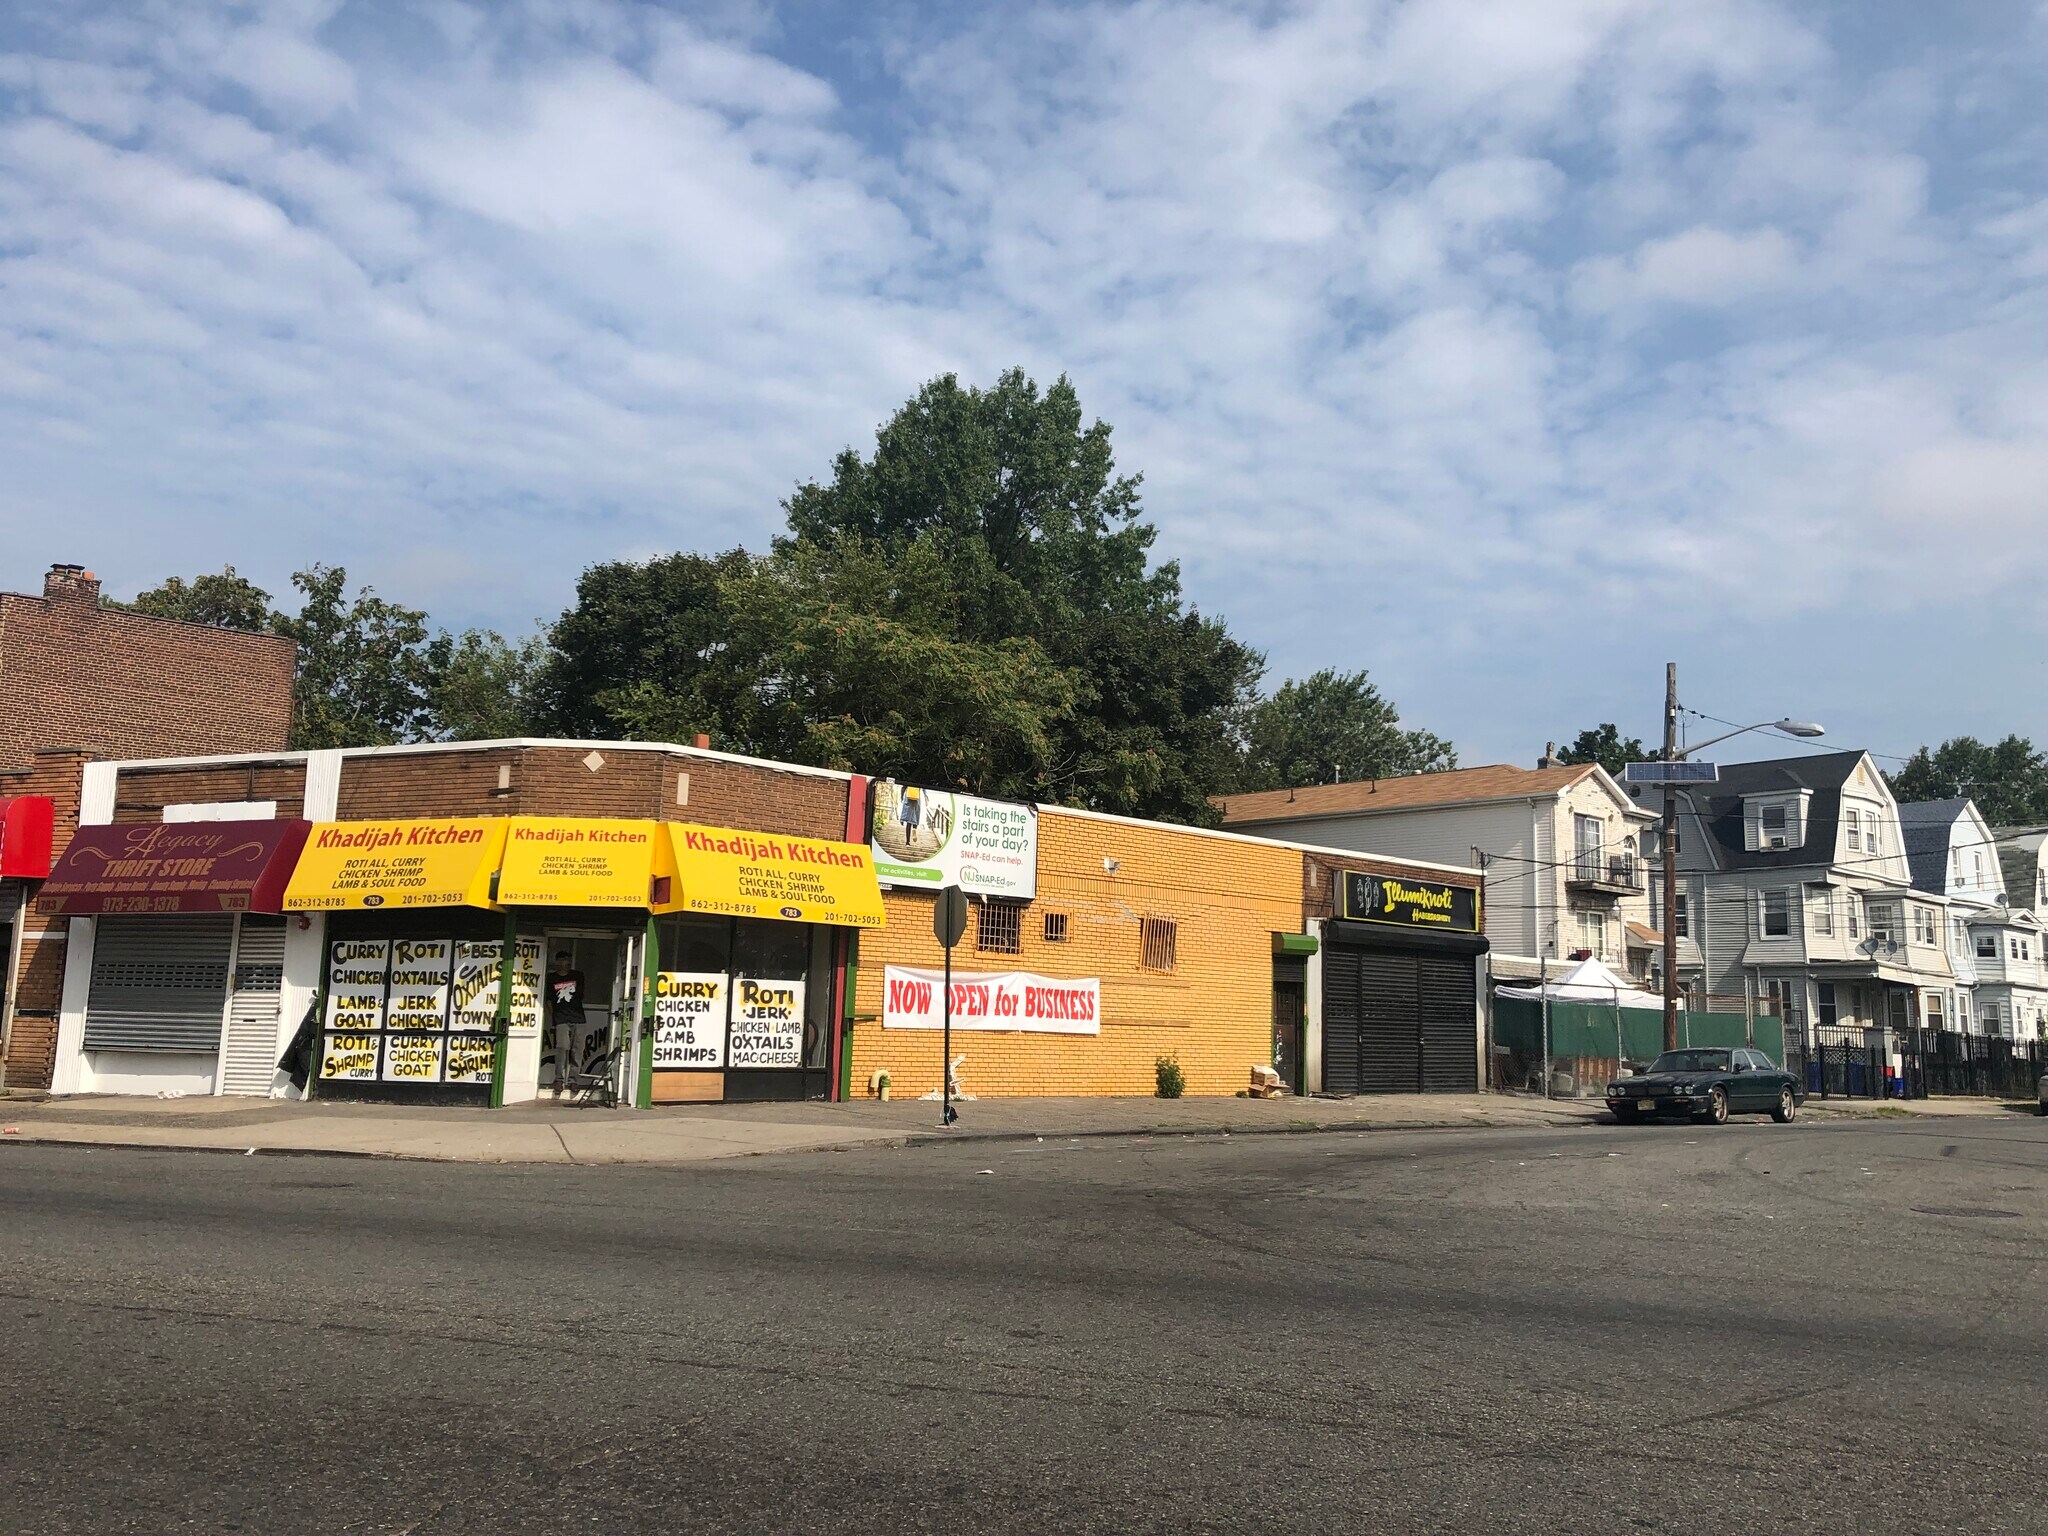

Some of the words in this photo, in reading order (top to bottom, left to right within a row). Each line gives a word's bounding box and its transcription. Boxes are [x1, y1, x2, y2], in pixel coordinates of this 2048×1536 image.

[963, 803, 971, 816] Is
[973, 805, 1007, 824] taking
[1010, 811, 1027, 824] the
[515, 828, 584, 844] Khadijah
[589, 830, 647, 843] Kitchen
[962, 818, 989, 833] stairs
[992, 825, 1000, 834] a
[1002, 825, 1025, 840] part
[124, 824, 227, 859] Legacy
[316, 827, 403, 852] Khadijah
[405, 825, 484, 846] Kitchen
[962, 833, 974, 845] of
[975, 837, 998, 850] your
[1001, 839, 1029, 854] day?
[685, 831, 784, 862] Khadijah
[787, 843, 865, 868] Kitchen
[345, 858, 368, 868] ROTI
[367, 858, 390, 869] ALL,
[391, 857, 426, 867] CURRY
[960, 850, 991, 862] SNAP-Ed
[992, 854, 1005, 863] can
[1006, 855, 1024, 867] help.
[102, 859, 161, 878] THRIFT
[158, 857, 216, 877] STORE
[338, 869, 380, 879] CHICKEN
[383, 867, 423, 878] SHRIMP
[739, 866, 764, 877] ROTI
[765, 869, 787, 881] ALL,
[788, 872, 820, 883] CURRY
[331, 879, 360, 889] LAMB
[360, 879, 369, 888] &
[369, 878, 396, 888] SOUL
[397, 877, 427, 887] FOOD
[739, 876, 783, 889] CHICKEN
[787, 882, 825, 894] SHRIMP
[228, 897, 246, 908] 783
[288, 898, 346, 907] 862-312-8785
[366, 896, 380, 905] 783
[402, 893, 463, 904] 201-702-5053
[504, 893, 558, 901] 862-312-8785
[589, 895, 642, 903] 201-702-5053
[738, 886, 769, 898] LAMB
[770, 890, 779, 899] &
[779, 891, 807, 902] SOUL
[808, 893, 836, 905] FOOD
[40, 899, 57, 911] 783
[102, 897, 180, 912] 973-230-1378
[691, 899, 757, 914] 862-312-8785
[784, 908, 798, 917] 783
[824, 912, 881, 925] 201-702-5053
[332, 942, 386, 965] CURRY
[395, 941, 446, 965] ROTI
[514, 943, 540, 959] ROTI
[332, 969, 386, 986] CHICKEN
[391, 970, 448, 986] OXTAILS
[511, 972, 540, 988] CURRY
[453, 960, 502, 1011] OXTAILS
[656, 974, 718, 999] CURRY
[740, 980, 794, 1005] ROTI
[336, 995, 376, 1010] LAMB
[397, 995, 437, 1010] JERK
[485, 993, 497, 1005] IN
[511, 992, 538, 1008] GOAT
[656, 1000, 710, 1013] CHICKEN
[888, 979, 932, 1014] NOW
[944, 982, 989, 1016] OPEN
[994, 984, 1019, 1016] for
[1025, 986, 1095, 1021] BUSINESS
[334, 1013, 375, 1028] GOAT
[452, 1010, 492, 1025] TOWN
[509, 1012, 536, 1028] LAMB
[745, 1006, 789, 1020] JERK
[388, 1013, 444, 1029] CHICKEN
[730, 1021, 770, 1034] CHICKEN
[775, 1022, 801, 1034] LAMB
[333, 1035, 370, 1050] ROTI
[390, 1036, 439, 1049] CURRY
[450, 1036, 496, 1052] CURRY
[655, 1030, 696, 1045] LAMB
[732, 1034, 794, 1051] OXTAILS
[389, 1050, 440, 1062] CHICKEN
[653, 1047, 717, 1062] SHRIMPS
[325, 1053, 375, 1078] SHRIMP
[350, 1068, 374, 1078] CURRY
[393, 1064, 431, 1077] GOAT
[448, 1054, 496, 1080] SHRIMP
